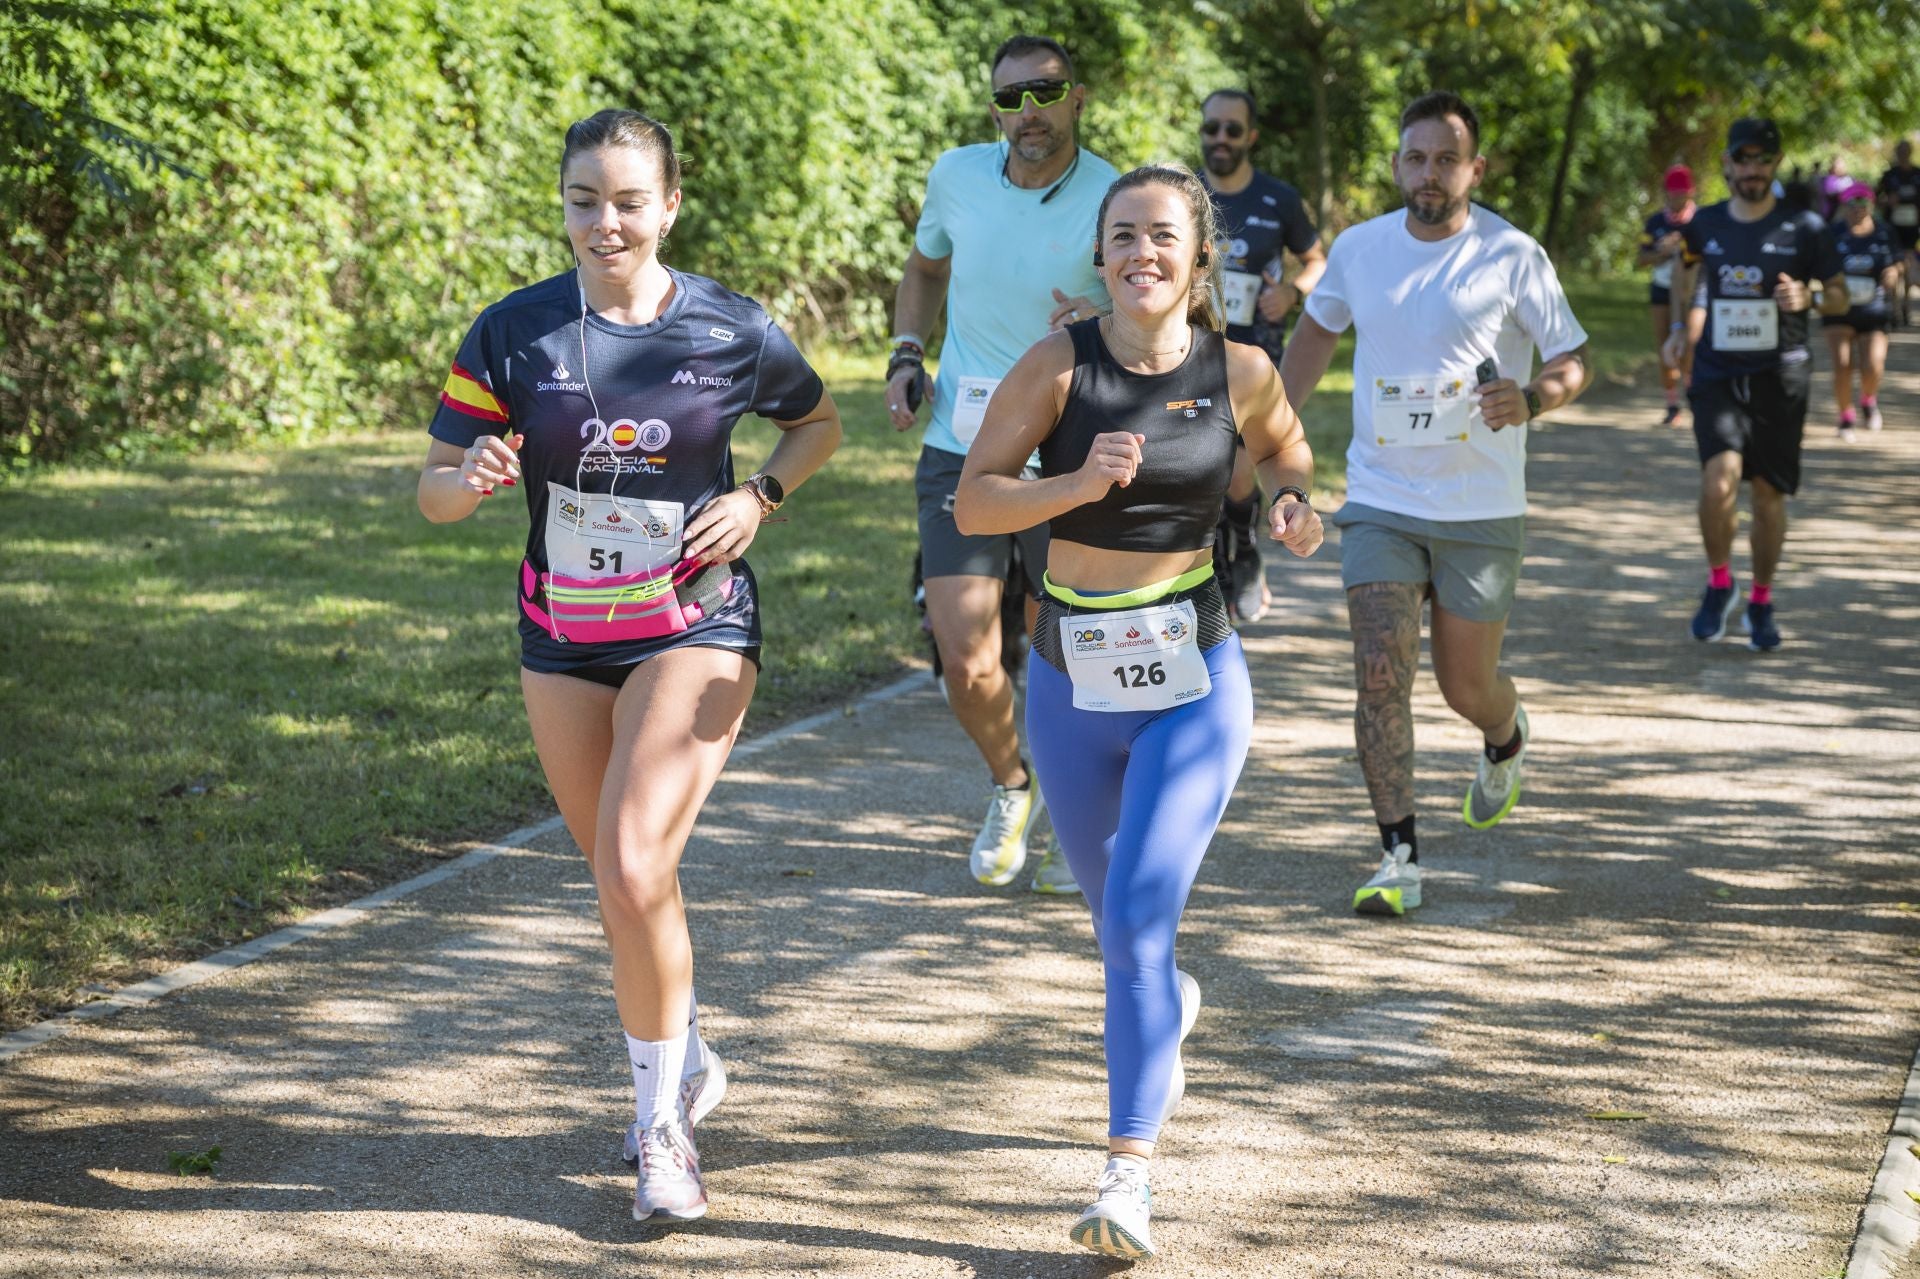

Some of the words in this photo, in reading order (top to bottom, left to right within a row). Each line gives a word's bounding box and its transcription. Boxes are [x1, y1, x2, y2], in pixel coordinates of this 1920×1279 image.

[537, 381, 586, 391] Santander
[699, 375, 734, 389] mupol
[1409, 413, 1432, 429] 77
[580, 418, 671, 452] 200
[579, 464, 664, 474] NACIONAL
[592, 521, 634, 534] Santander
[589, 548, 623, 574] 51
[1074, 629, 1104, 643] 200
[1114, 638, 1155, 649] Santander
[1113, 661, 1167, 688] 126
